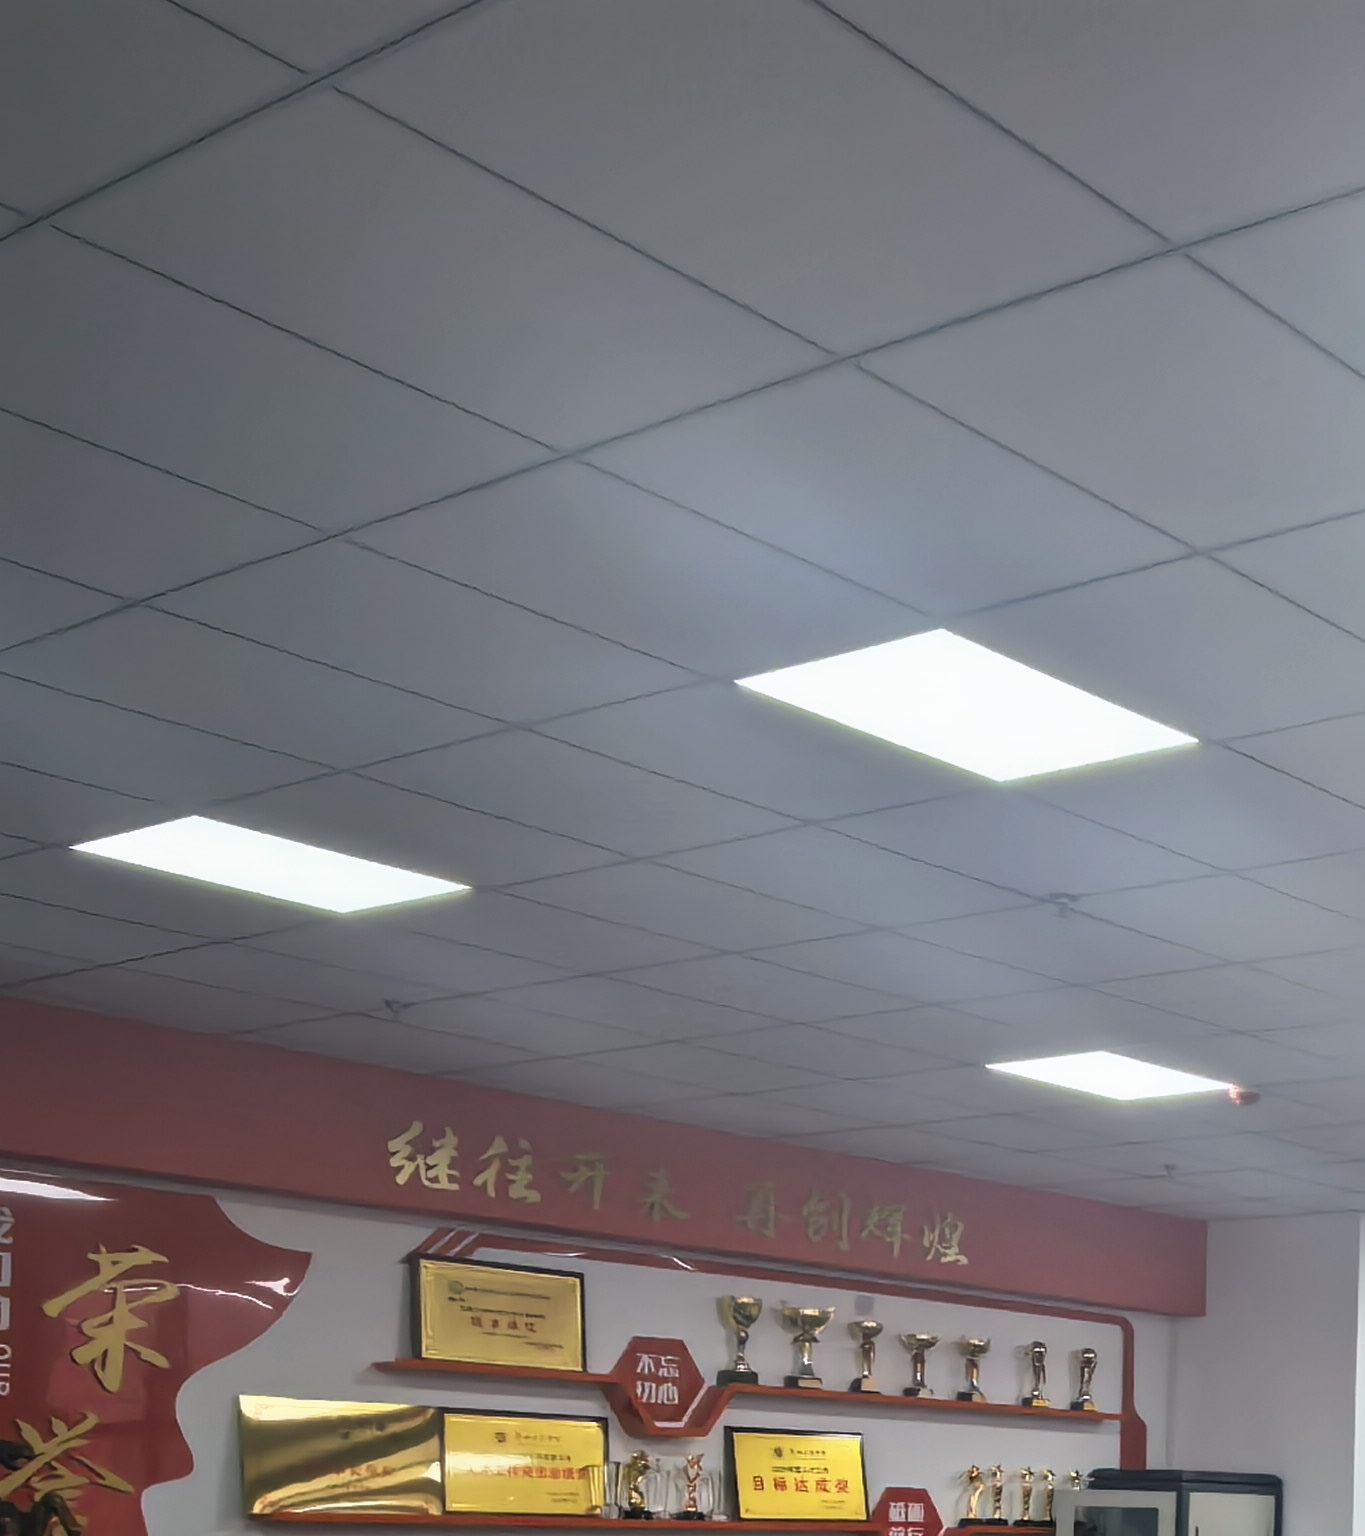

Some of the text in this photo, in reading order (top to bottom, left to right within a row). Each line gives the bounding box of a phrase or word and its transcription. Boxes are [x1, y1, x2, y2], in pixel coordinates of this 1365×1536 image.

[387, 1120, 969, 1265] 继往开来 再创辉煌
